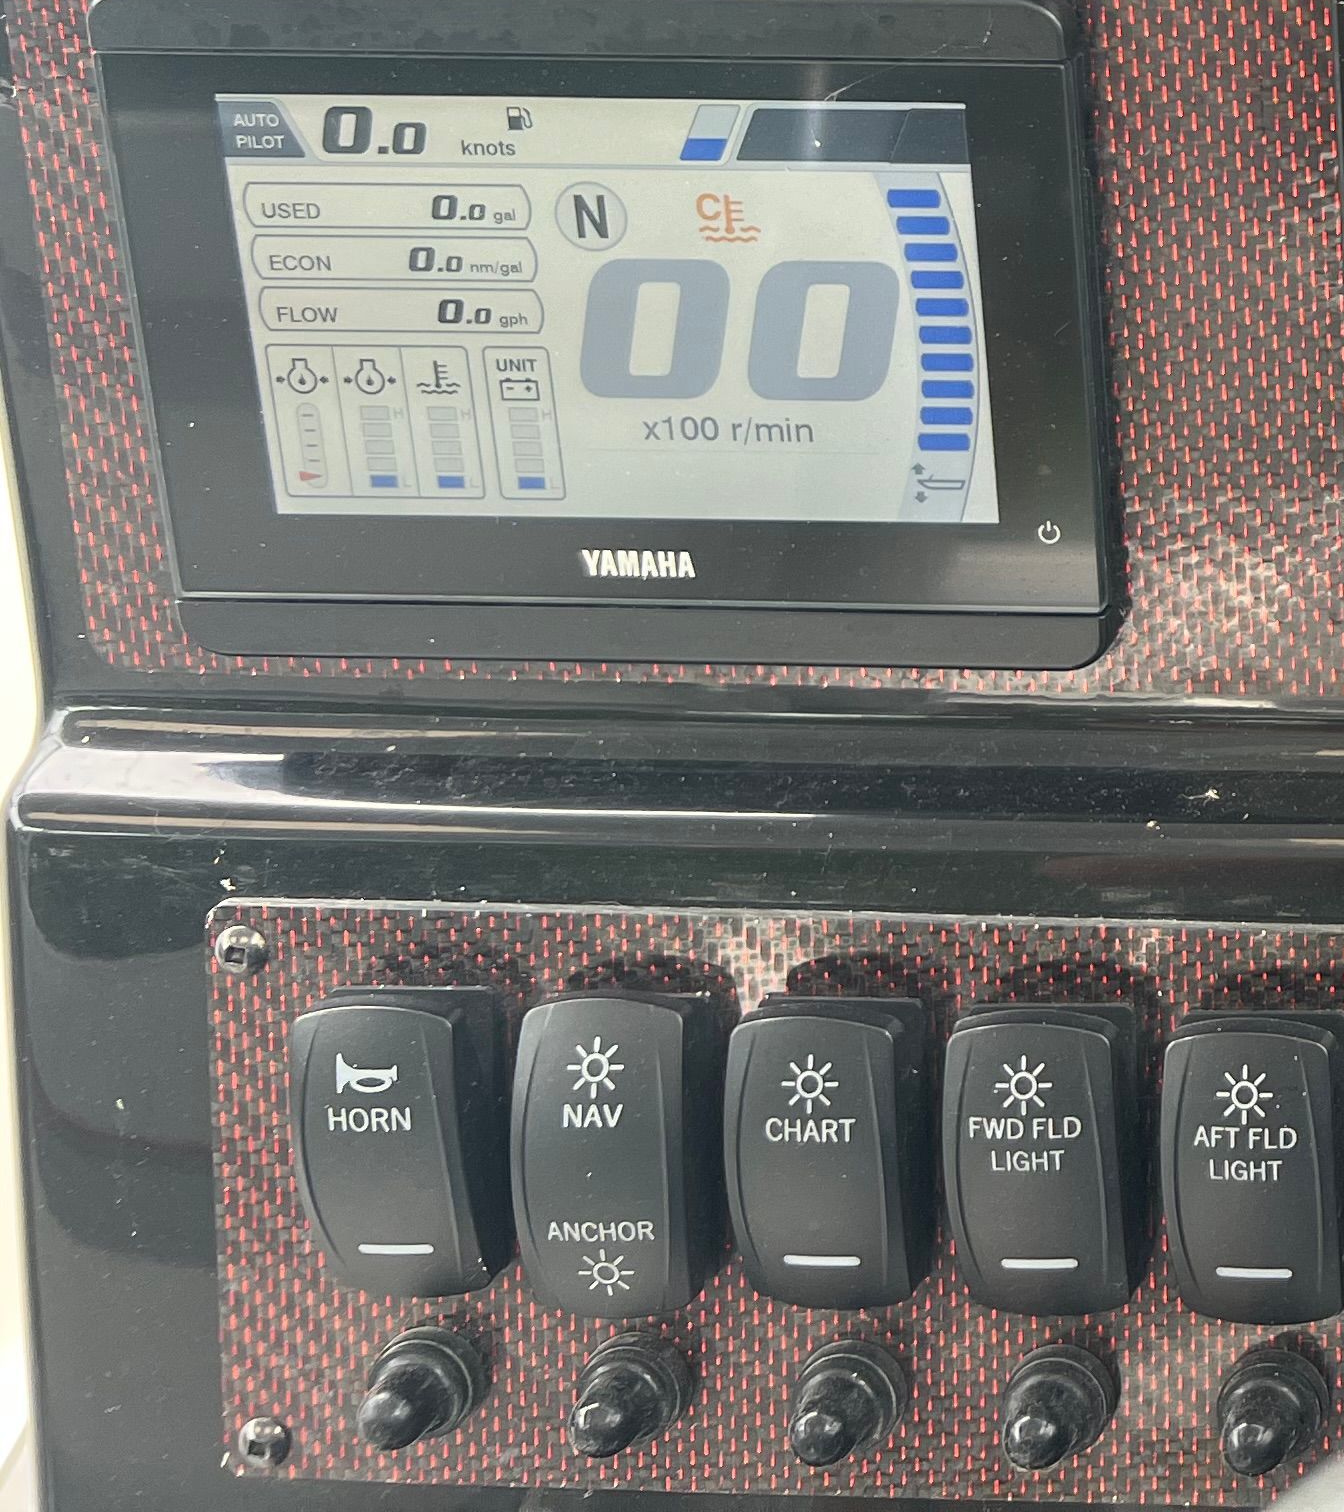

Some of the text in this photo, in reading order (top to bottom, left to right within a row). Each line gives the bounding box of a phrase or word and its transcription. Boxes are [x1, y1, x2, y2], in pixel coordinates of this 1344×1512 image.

[233, 113, 280, 127] AUTO
[322, 106, 427, 154] 0.0
[236, 135, 285, 149] PILOT
[461, 139, 516, 156] knots
[261, 195, 517, 224] USED 0.0 gal
[573, 193, 610, 239] N
[269, 247, 523, 276] ECON 0.0 nm/gal
[276, 299, 528, 328] FLOW 0.0 gph
[579, 258, 900, 401] 00
[495, 358, 537, 372] UNIT
[644, 417, 814, 445] x100 r/min
[582, 550, 696, 578] YAMAHA
[327, 1107, 412, 1133] HORN
[563, 1104, 623, 1128] NAV
[968, 1116, 1082, 1140] FWD FLD
[765, 1118, 855, 1143] CHART
[1194, 1127, 1298, 1151] AFT FLD
[991, 1150, 1065, 1173] LIGHT
[1209, 1159, 1283, 1183] LIGHT
[548, 1220, 655, 1242] ANCHOR
